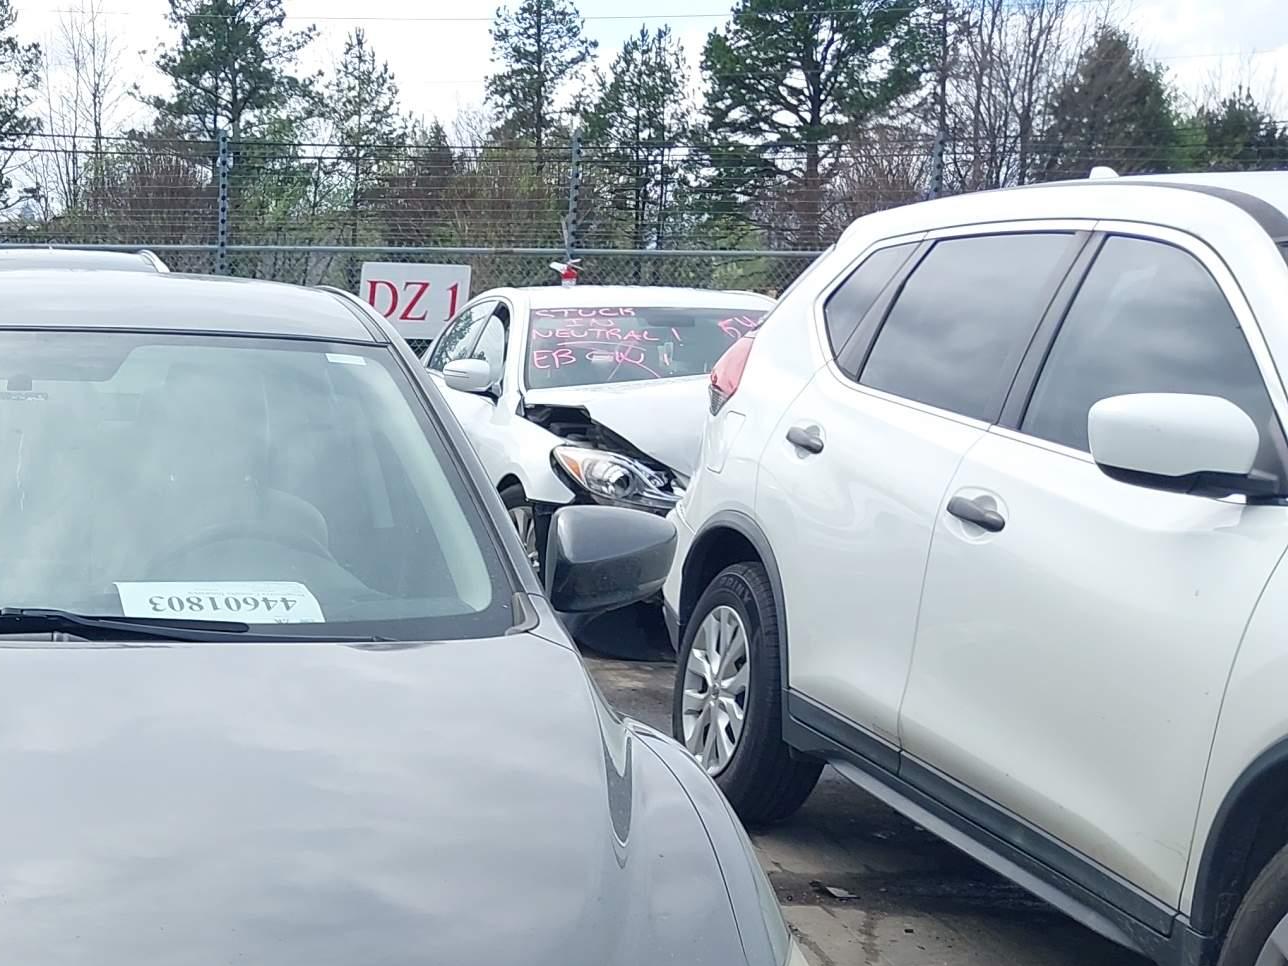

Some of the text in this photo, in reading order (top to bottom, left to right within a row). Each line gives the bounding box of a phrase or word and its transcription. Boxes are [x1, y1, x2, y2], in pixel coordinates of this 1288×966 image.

[366, 279, 431, 321] DZ
[535, 307, 636, 318] STUCK
[565, 318, 615, 328] IN
[531, 327, 661, 341] NEUTRAL
[532, 348, 577, 370] EB
[148, 595, 298, 613] 44601803
